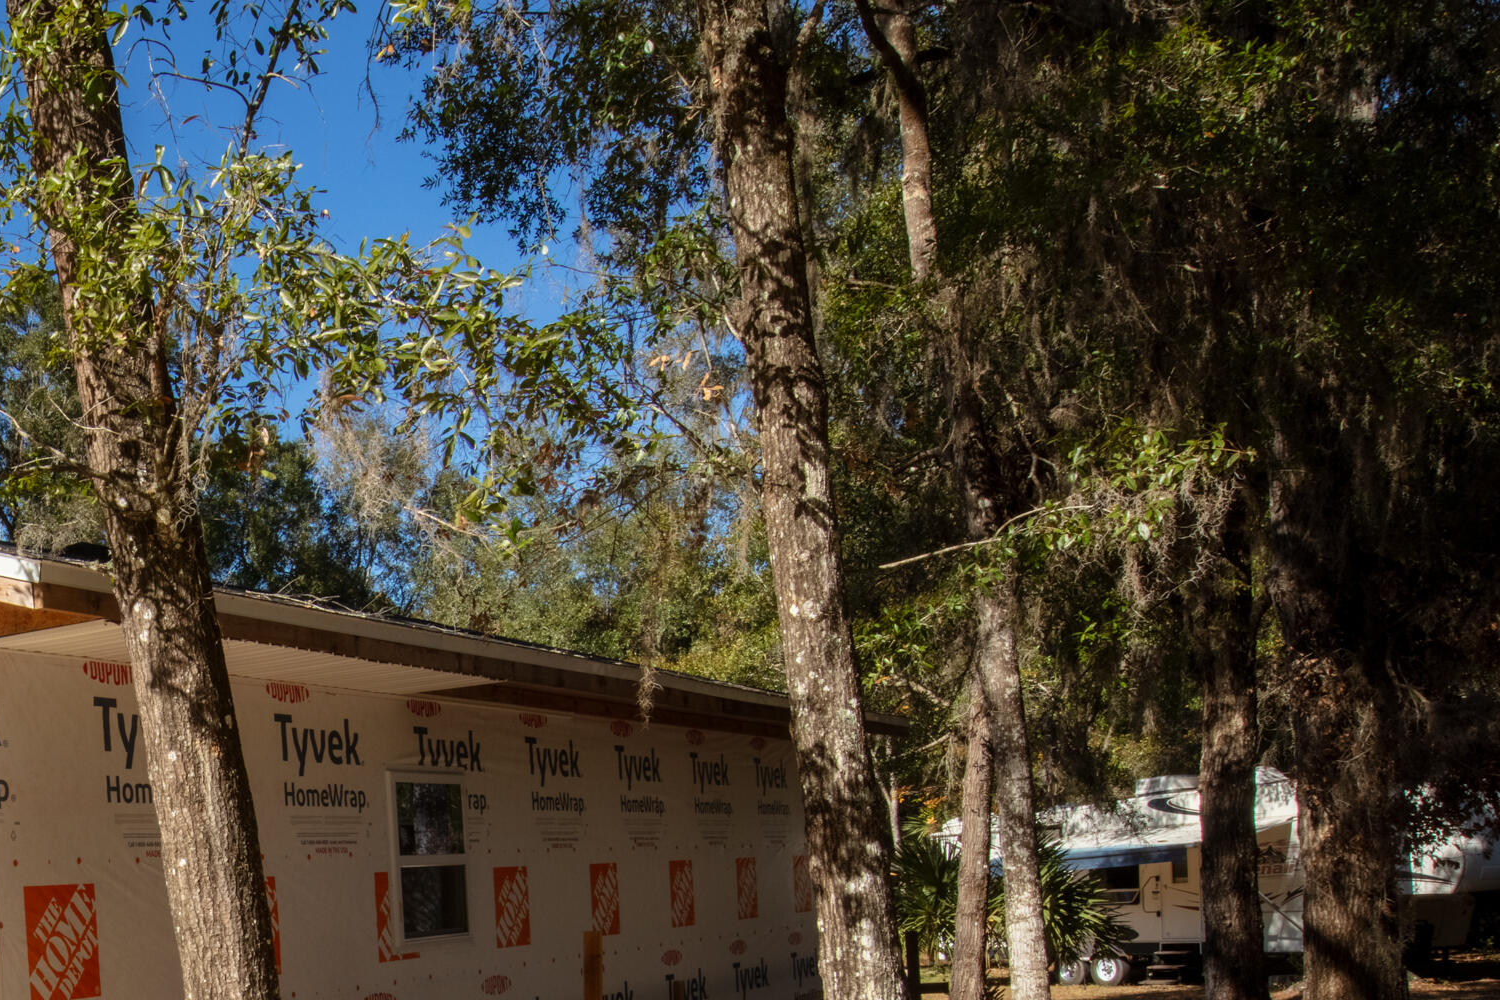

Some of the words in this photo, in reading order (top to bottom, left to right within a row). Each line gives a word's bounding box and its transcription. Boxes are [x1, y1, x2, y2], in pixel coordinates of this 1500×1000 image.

[271, 682, 305, 703] DUPONT
[274, 713, 361, 776] Tyvek
[525, 736, 581, 787] Tyvek
[614, 744, 661, 791] Tyvek
[689, 752, 730, 794] Tyvek
[753, 757, 788, 797] Tyvek
[284, 782, 366, 813] HomeWrap
[531, 791, 585, 816] HomeWrap
[33, 896, 62, 945] THE
[59, 925, 100, 1000] DEPOT
[732, 957, 770, 1000] Tyvek
